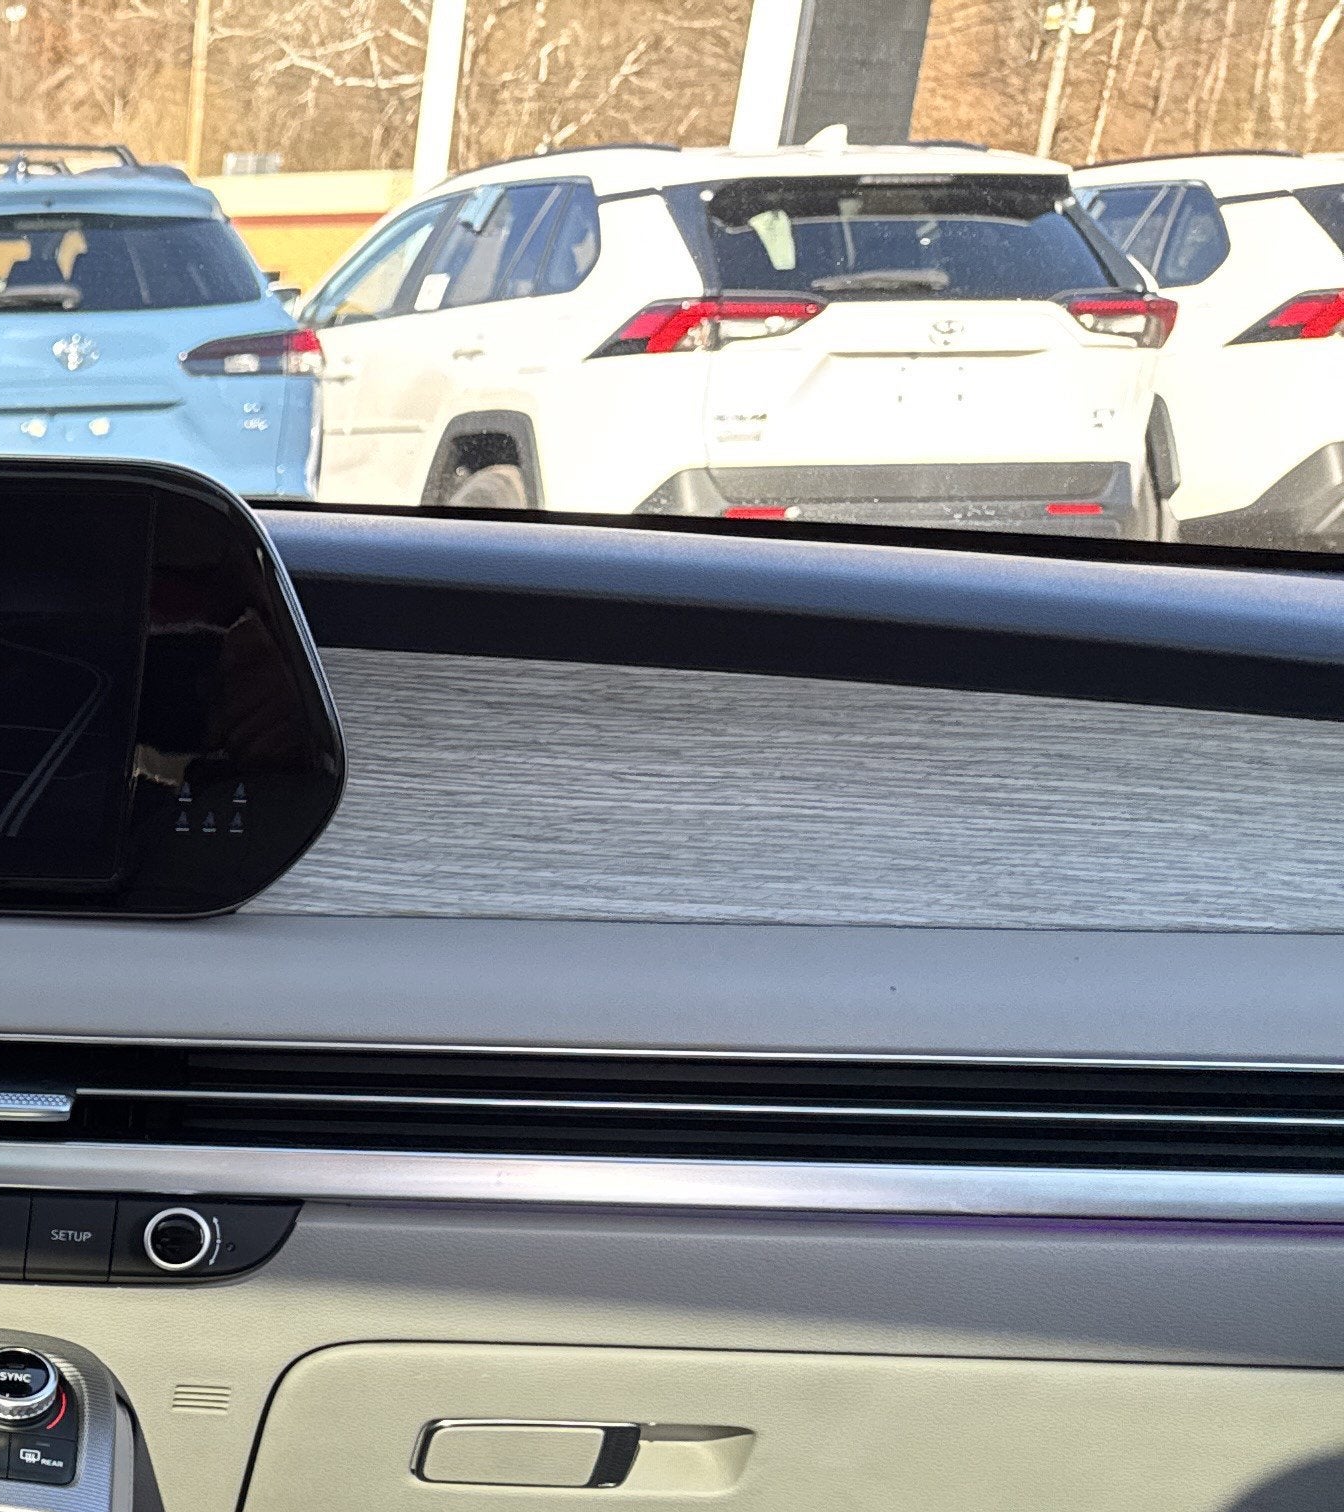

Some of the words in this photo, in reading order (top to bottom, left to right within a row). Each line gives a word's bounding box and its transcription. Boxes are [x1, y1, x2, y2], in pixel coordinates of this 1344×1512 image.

[51, 1229, 93, 1242] SETUP
[0, 1371, 32, 1383] SYNC
[40, 1458, 64, 1467] REAR
